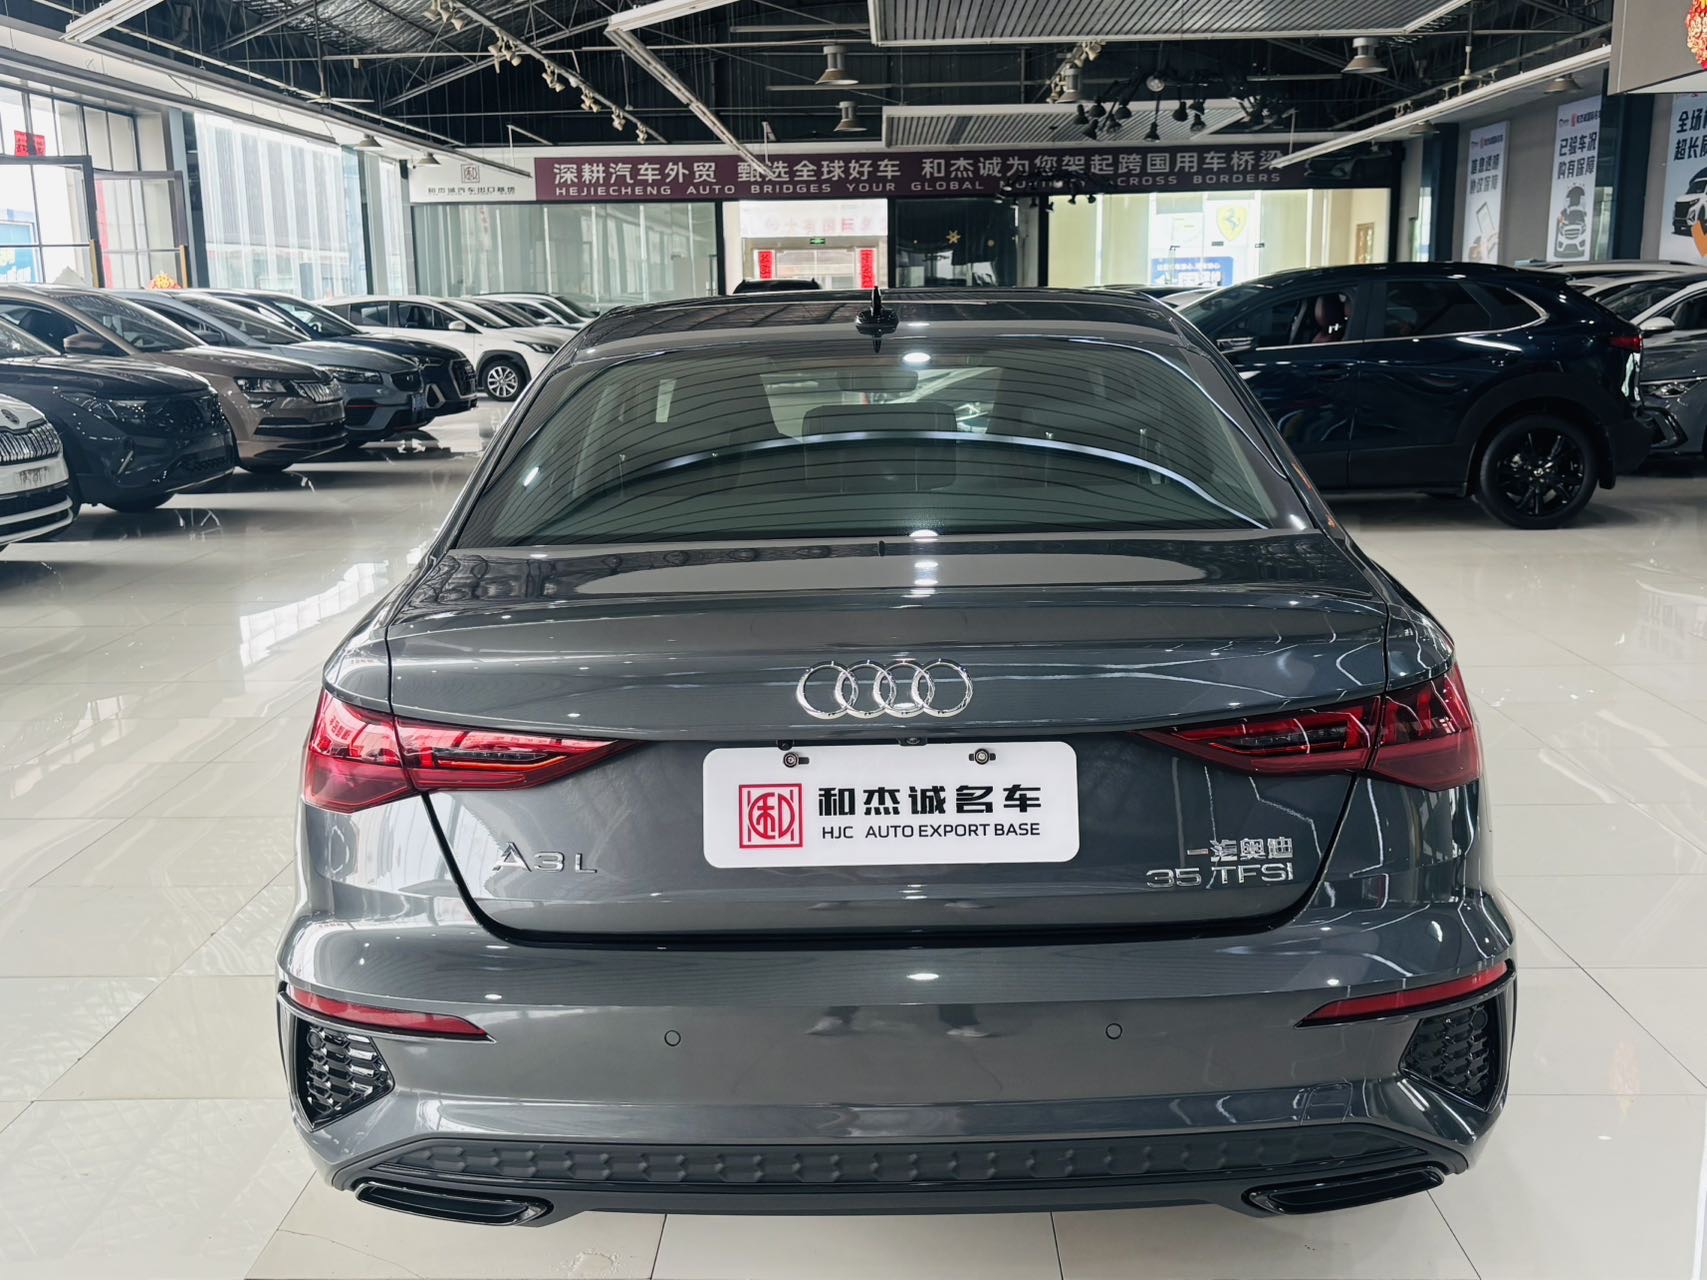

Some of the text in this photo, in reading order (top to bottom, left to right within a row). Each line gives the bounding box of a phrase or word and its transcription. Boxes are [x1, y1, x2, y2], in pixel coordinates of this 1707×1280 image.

[553, 150, 1282, 185] 深耕汽车外贸 甄选全球好车 和杰诚为您架起跨国用车桥梁
[556, 173, 1281, 196] HEJIECHENG AUTO BRIDGES YOUR GLOBAL CROSS BORDERS
[818, 784, 1042, 816] 和杰诚名车
[822, 822, 1041, 839] HJC AUTO EXPORT BASE
[1187, 836, 1293, 862] 一汽奥迪
[1146, 862, 1294, 888] 35 TFSI
